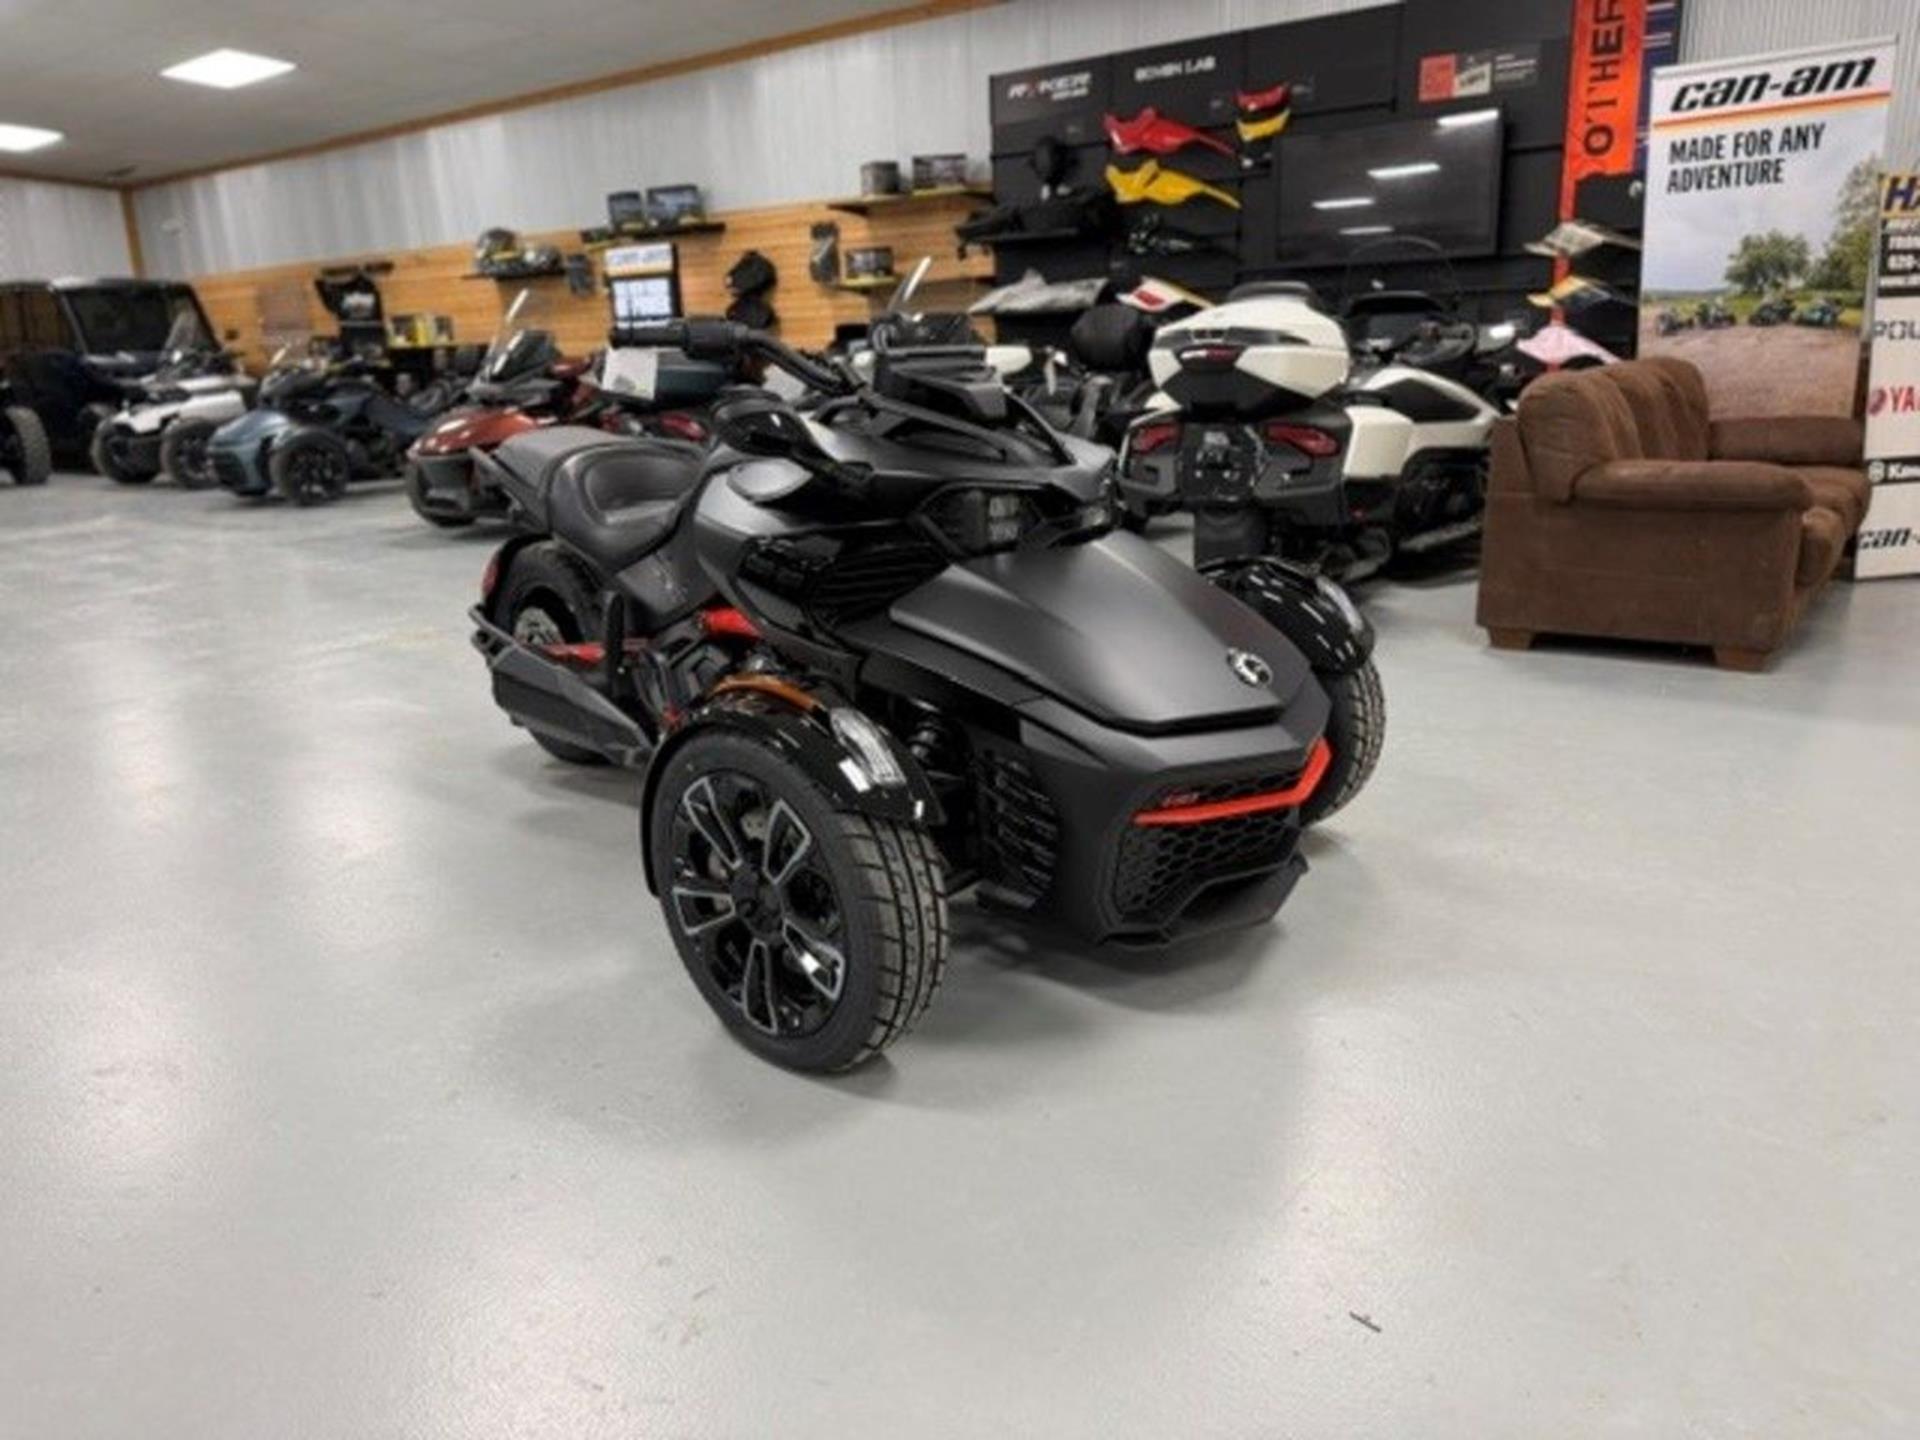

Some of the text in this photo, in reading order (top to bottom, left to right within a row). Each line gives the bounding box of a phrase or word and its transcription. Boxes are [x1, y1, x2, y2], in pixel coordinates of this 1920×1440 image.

[1670, 57, 1877, 113] can-am
[1668, 123, 1827, 165] MADE FOR ANY
[1667, 158, 1786, 194] ADVENTURE
[1890, 386, 1920, 413] YA
[1859, 528, 1920, 549] can-
